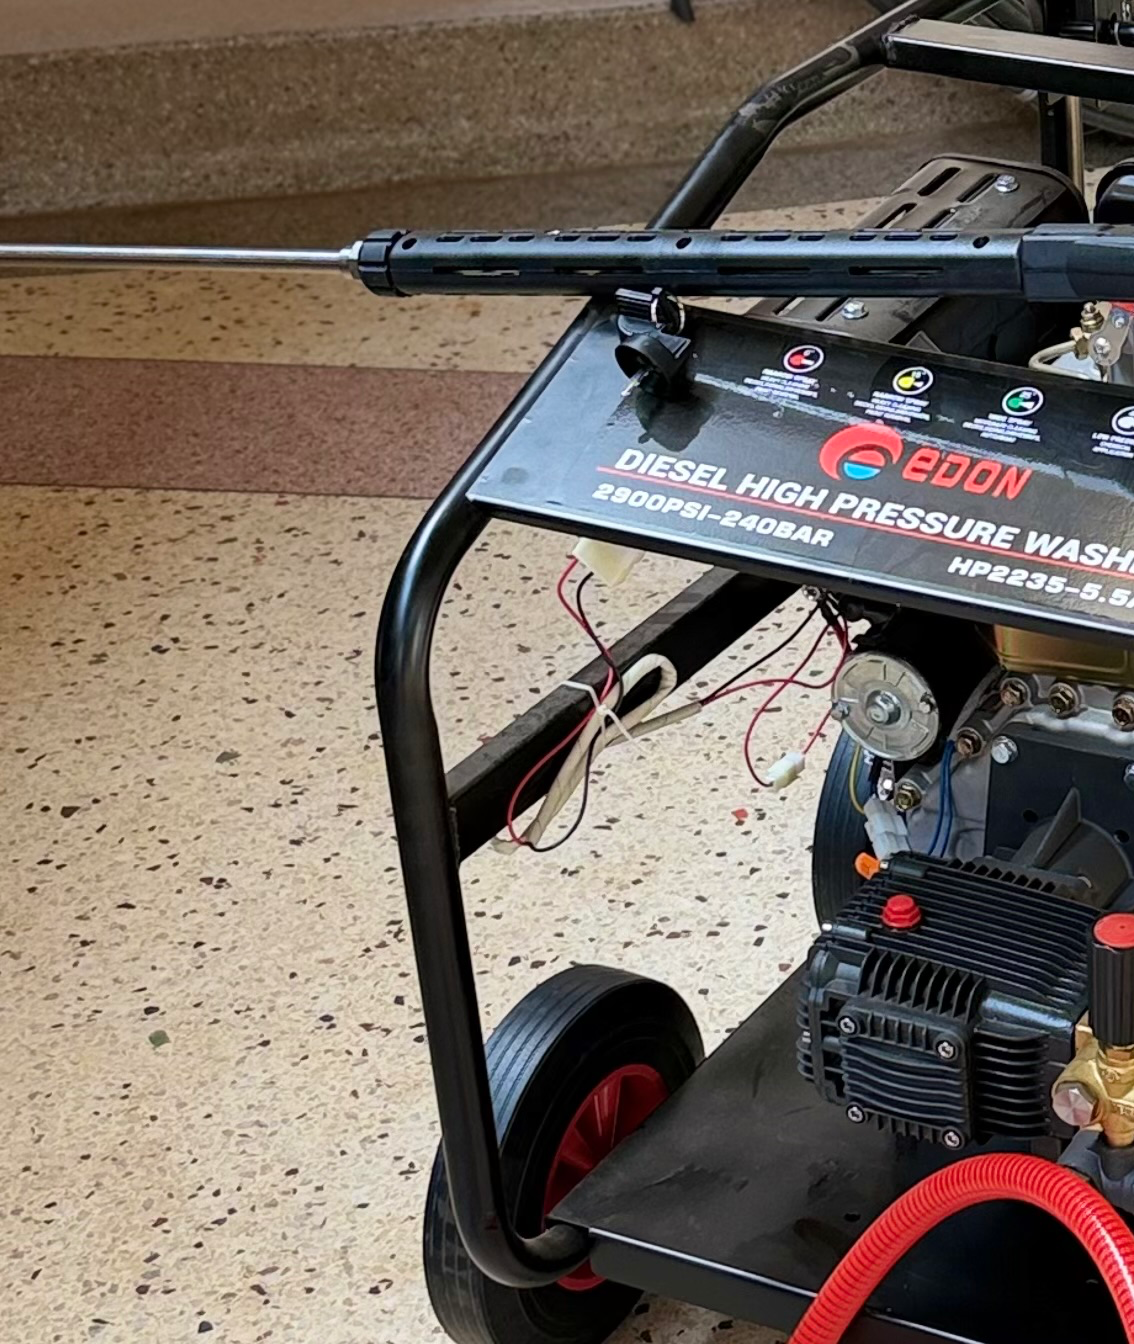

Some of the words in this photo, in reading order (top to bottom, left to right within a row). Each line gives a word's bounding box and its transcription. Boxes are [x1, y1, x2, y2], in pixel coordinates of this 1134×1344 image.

[591, 482, 835, 548] 2900PSI-240BAR
[614, 448, 728, 491] DIESEL
[736, 473, 829, 511] HIGH
[829, 489, 1020, 549] PRESSURE
